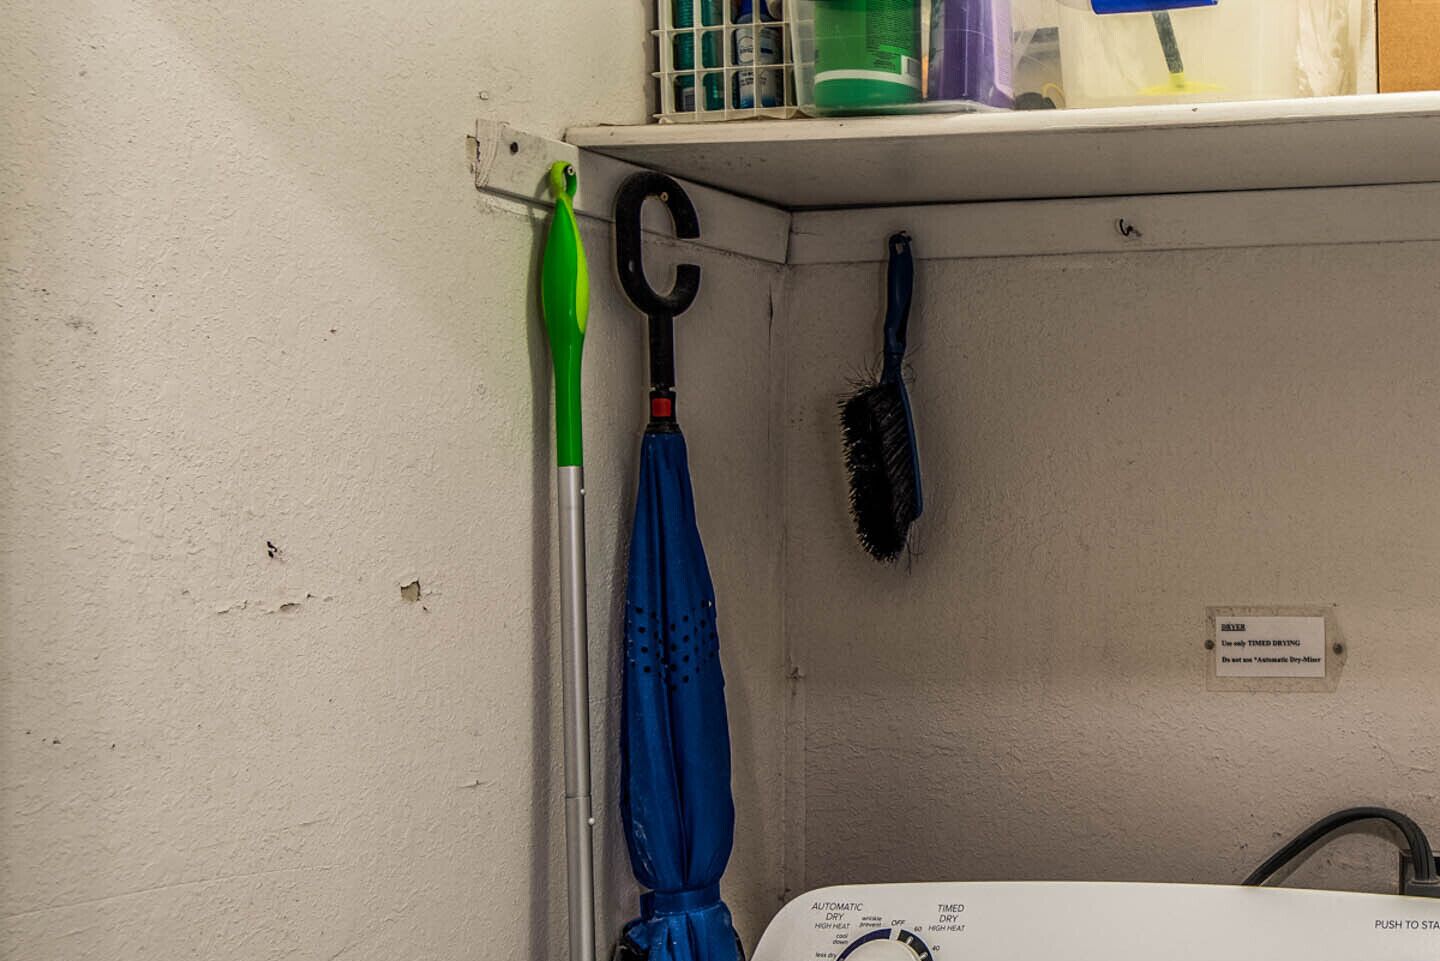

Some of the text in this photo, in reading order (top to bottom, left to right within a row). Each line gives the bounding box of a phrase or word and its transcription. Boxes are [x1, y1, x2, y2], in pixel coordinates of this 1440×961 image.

[1221, 623, 1246, 631] DRYER
[1233, 640, 1246, 648] only
[811, 902, 863, 911] AUTOMATIC
[937, 904, 964, 912] TIMED
[826, 912, 844, 921] DRY
[939, 914, 959, 923] DRY
[1374, 920, 1402, 929] PUSH
[1406, 920, 1419, 929] TO
